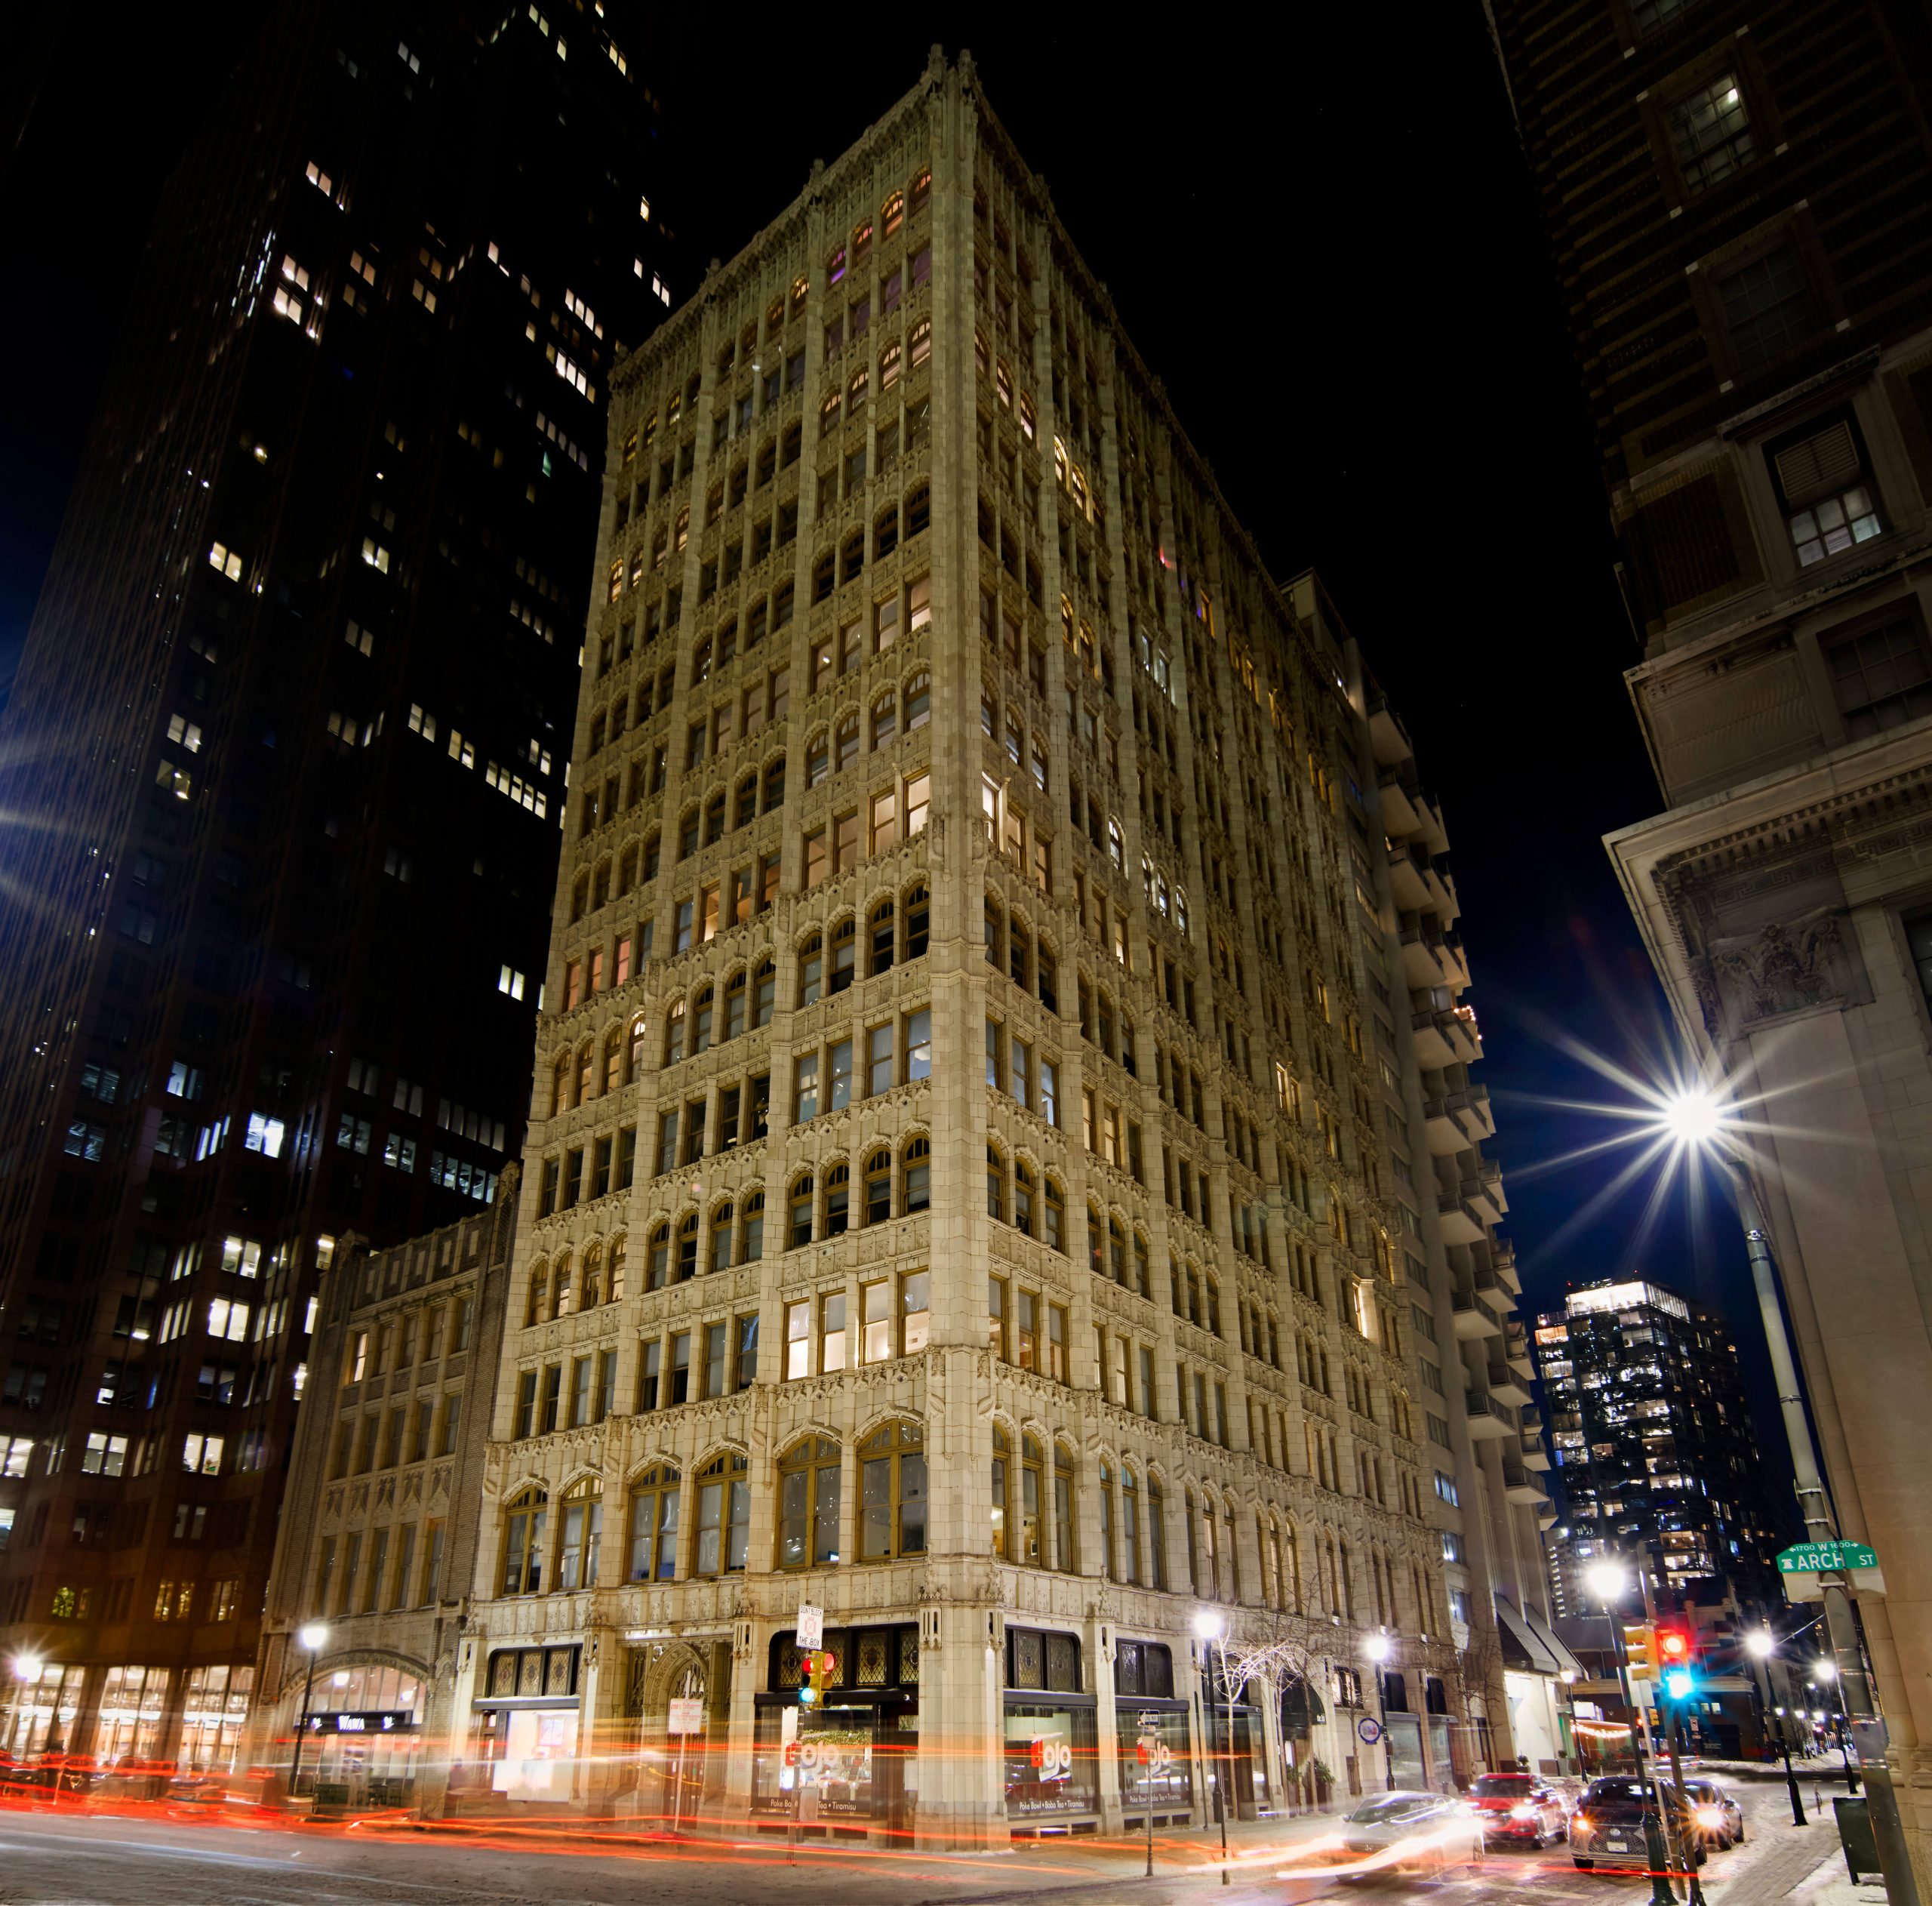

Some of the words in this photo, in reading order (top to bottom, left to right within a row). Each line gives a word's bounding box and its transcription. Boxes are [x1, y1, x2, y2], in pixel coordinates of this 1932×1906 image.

[1817, 1543, 1827, 1551] W
[1798, 1552, 1845, 1569] ARCH
[1859, 1554, 1873, 1566] ST
[799, 1636, 808, 1645] THE
[810, 1638, 820, 1647] BOX
[771, 1799, 783, 1807] Poke
[817, 1800, 827, 1809] Tea
[832, 1801, 857, 1810] Tiramisu
[1020, 1801, 1030, 1810] Poke
[1031, 1800, 1041, 1809] Bowl
[1045, 1800, 1056, 1809] Boba
[1067, 1800, 1084, 1808] Tiramisu
